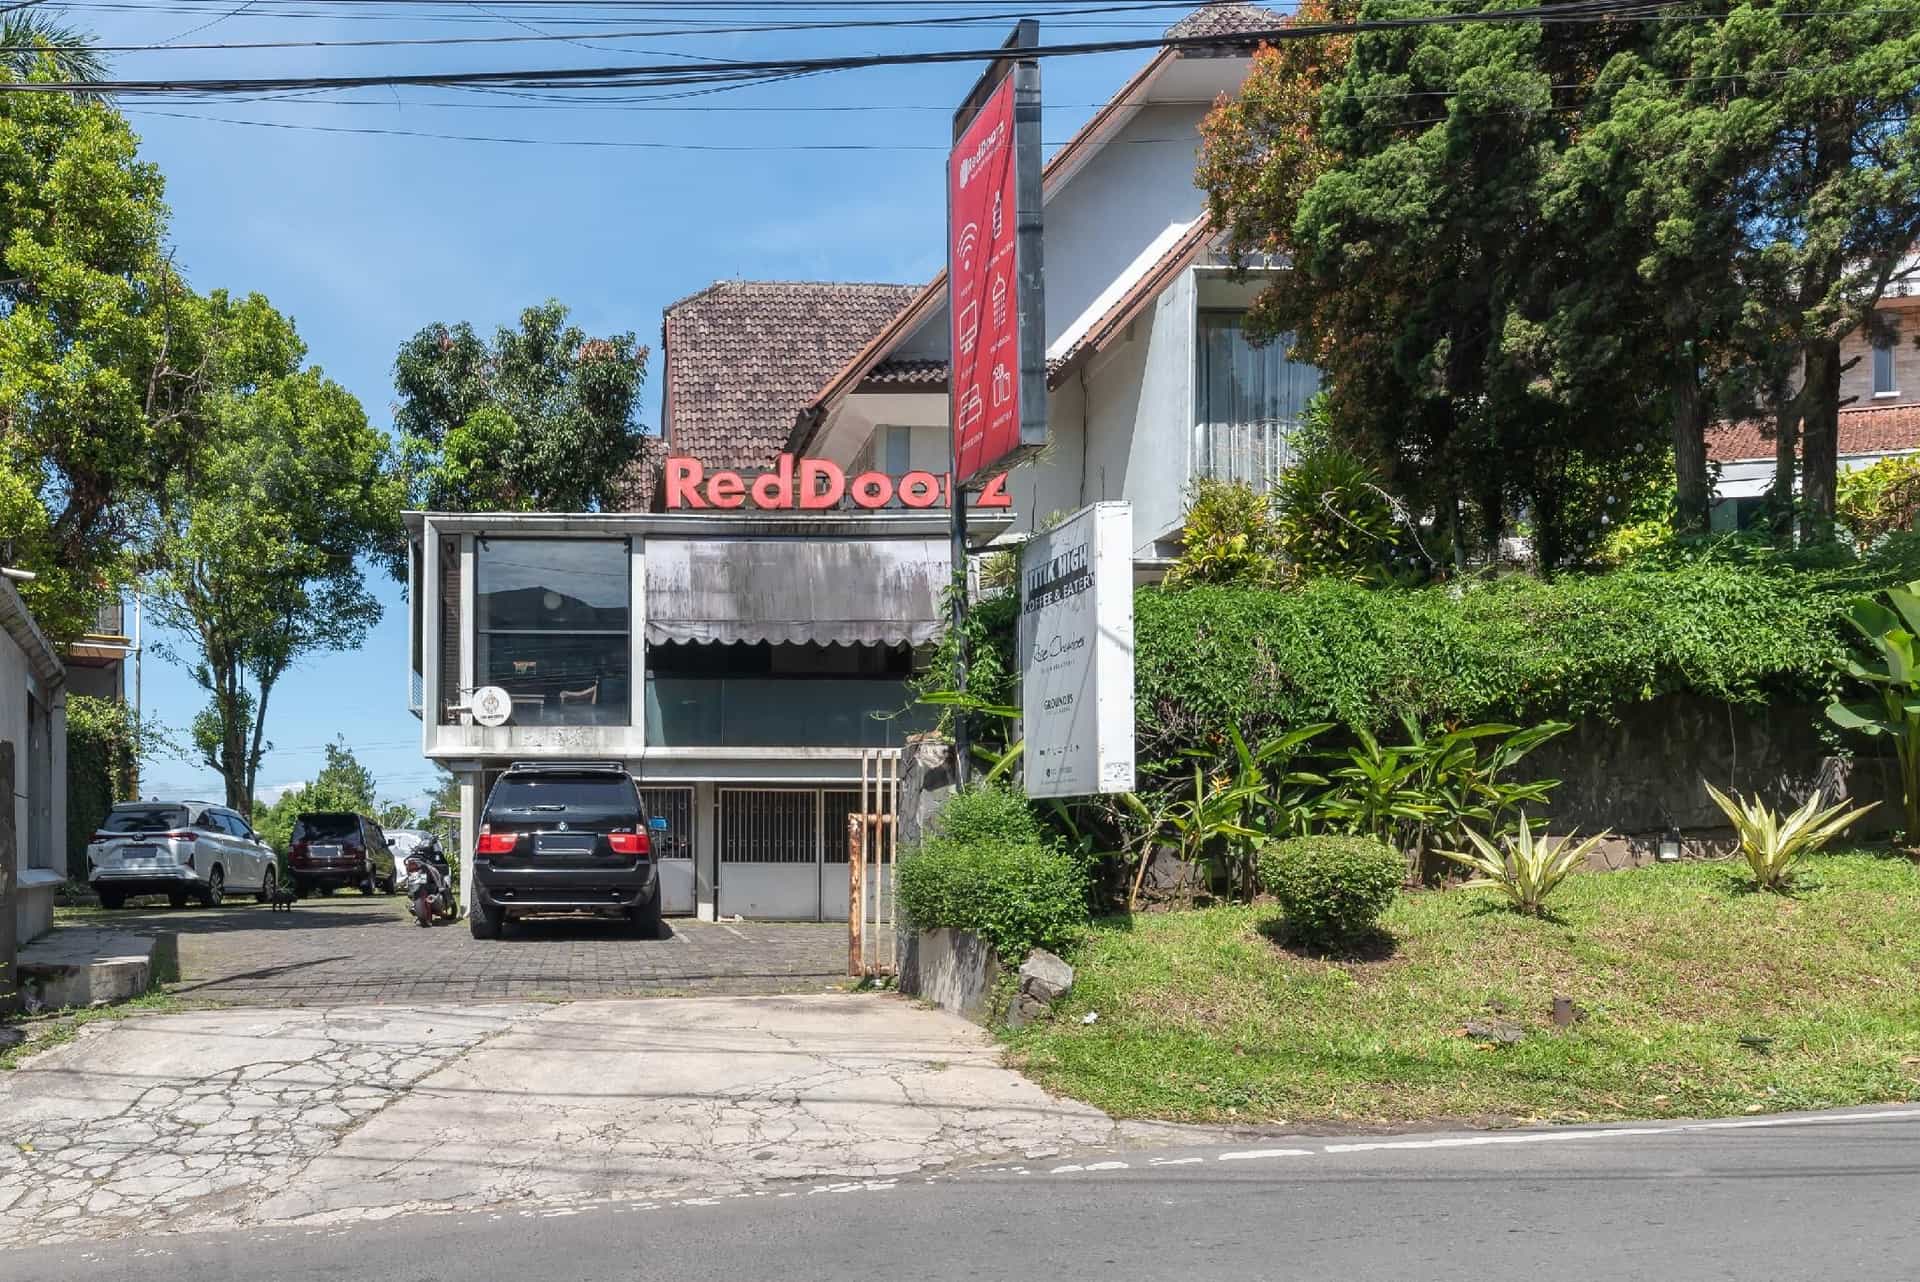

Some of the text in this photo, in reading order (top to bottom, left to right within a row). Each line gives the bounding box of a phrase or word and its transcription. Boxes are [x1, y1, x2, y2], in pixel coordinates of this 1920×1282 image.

[1027, 543, 1088, 593] TITIK HIGH
[1025, 573, 1095, 613] COFFEE & EATERY
